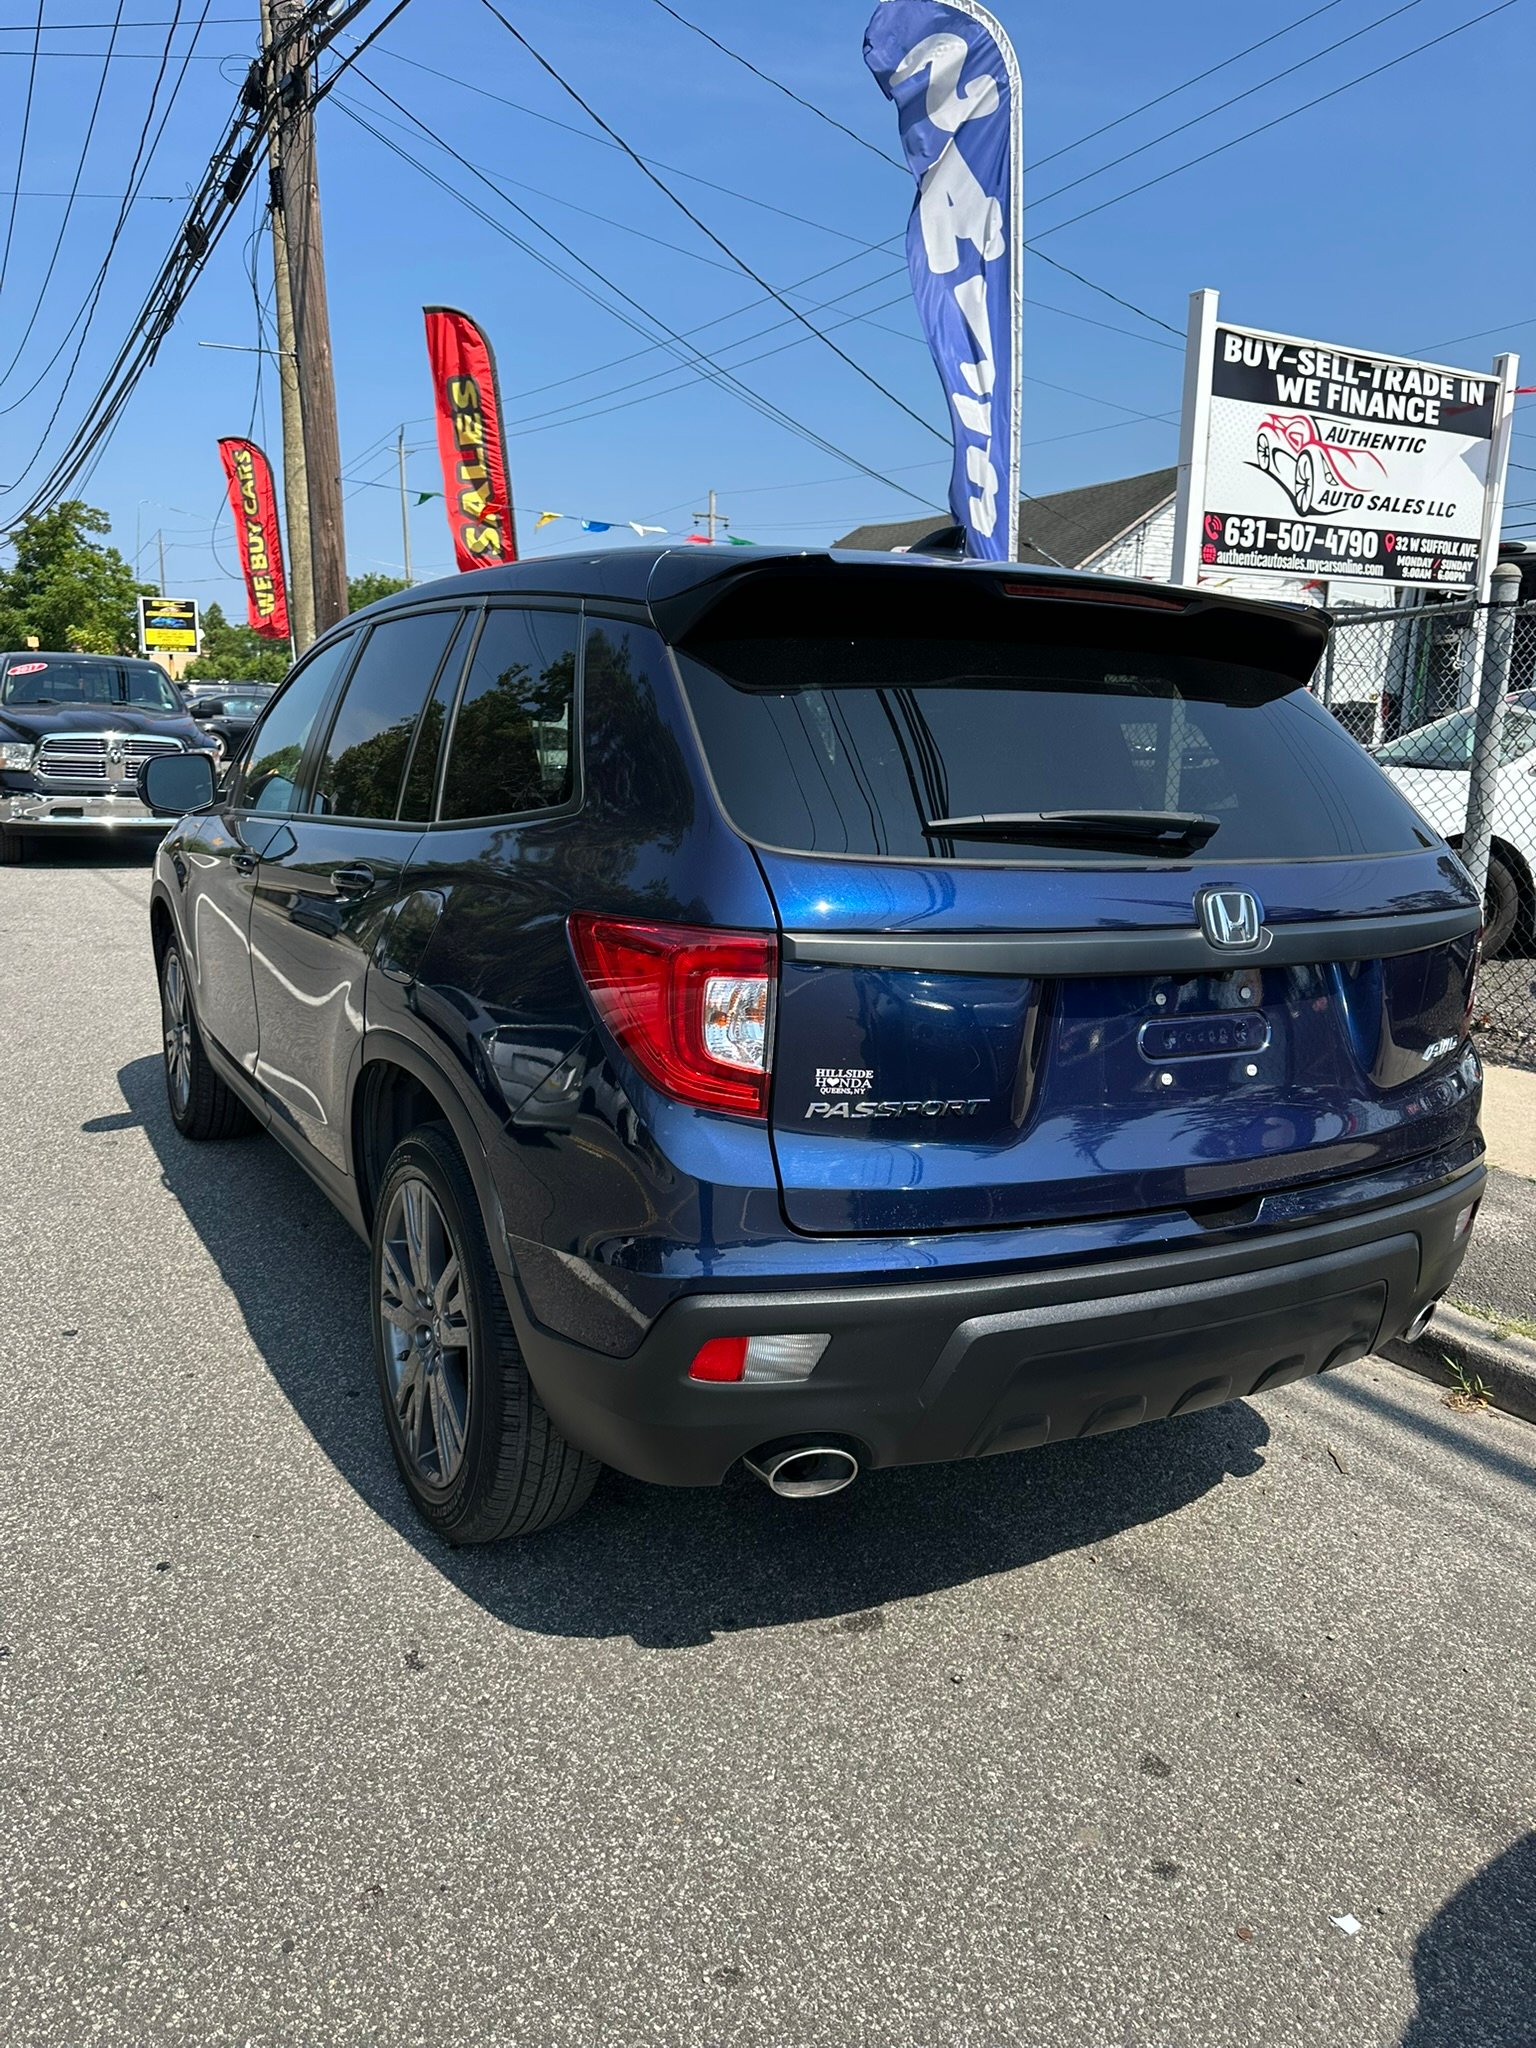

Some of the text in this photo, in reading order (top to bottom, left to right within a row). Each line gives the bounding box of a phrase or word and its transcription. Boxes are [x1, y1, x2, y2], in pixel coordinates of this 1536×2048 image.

[1223, 333, 1485, 406] BUY-SELL-TRADE IN
[1276, 374, 1441, 425] WE FINANCE
[1325, 426, 1427, 453] AUTHENTIC
[450, 378, 501, 556] SALES
[1318, 489, 1456, 518] AUTO SALES LLC
[234, 449, 275, 617] WE BUY CARS
[1224, 516, 1379, 559] 631-507-4790
[1395, 536, 1409, 551] 32
[1410, 537, 1420, 552] W
[1420, 539, 1459, 557] SUFFOLK
[1217, 549, 1384, 576] authenticautosales.mycarsonline.com
[1397, 555, 1434, 569] MONDAY
[1440, 559, 1473, 572] SUNDAY
[1402, 567, 1431, 580] 9:00AM
[815, 1068, 874, 1079] HILLSIDE
[820, 1087, 853, 1096] QUEENS,
[804, 1098, 991, 1119] PASSPORT
